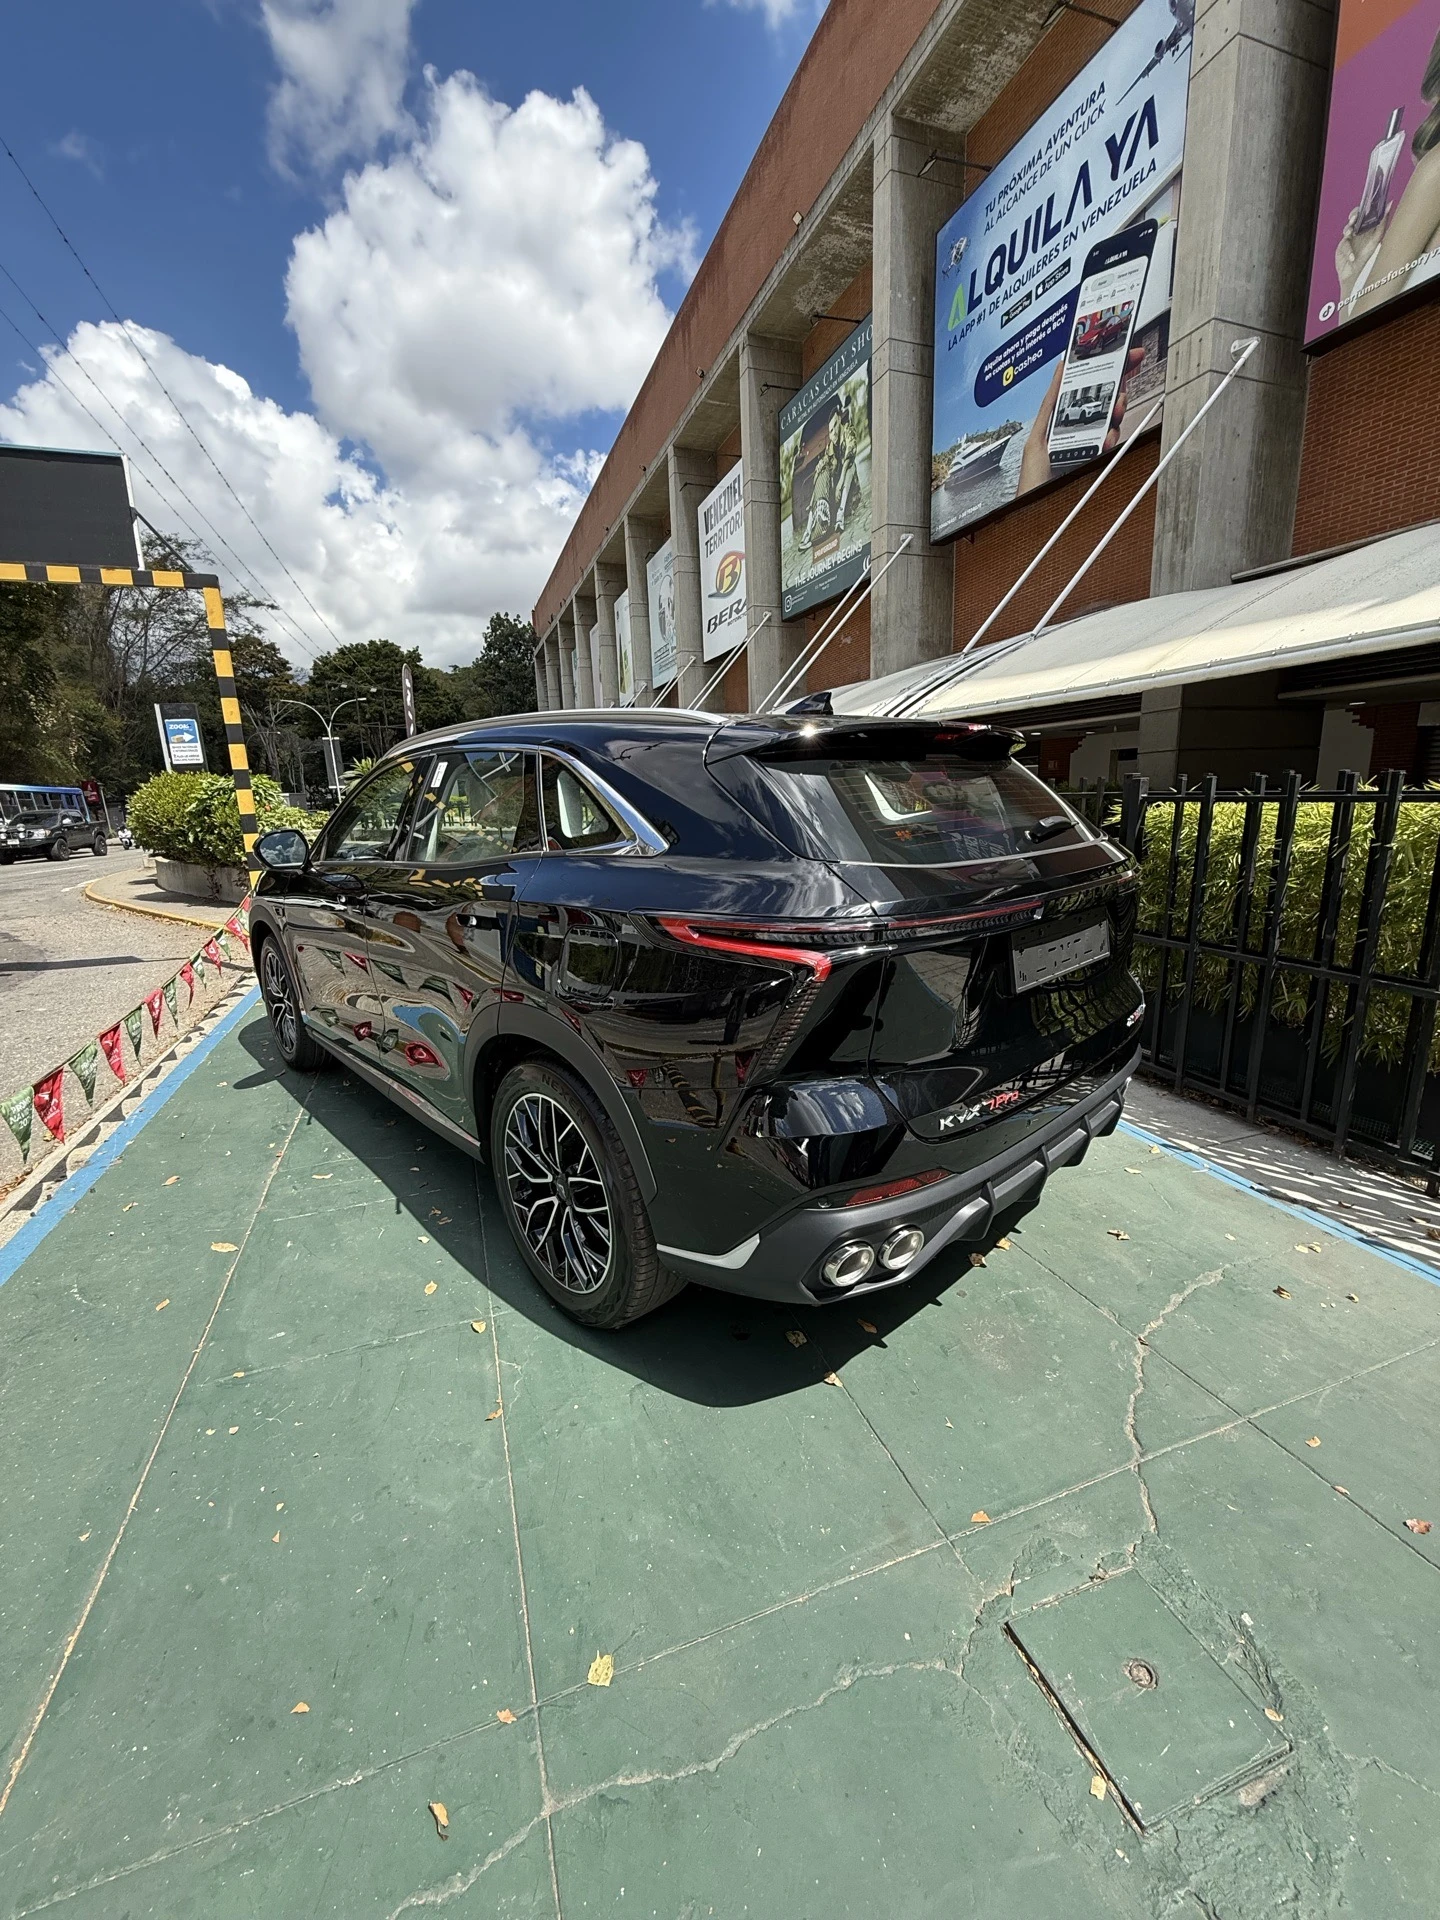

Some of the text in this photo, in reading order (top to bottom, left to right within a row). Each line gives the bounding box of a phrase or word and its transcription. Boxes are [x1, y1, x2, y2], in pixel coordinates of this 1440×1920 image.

[984, 81, 1106, 218] TU PRÓXIMA AVENTURA
[984, 99, 1107, 235] AL ALCANCE DE UN CLICK
[948, 95, 1159, 331] ALQUILA YA
[947, 334, 959, 351] LA
[959, 320, 976, 344] APP
[976, 309, 987, 326] #1
[988, 295, 1001, 316] DE
[1001, 243, 1061, 305] ALQUILERES
[1062, 226, 1079, 252] EN
[1081, 157, 1157, 234] VENEZUELA
[992, 359, 1012, 376] cuotas
[1016, 346, 1026, 359] sin
[1025, 330, 1047, 351] interés
[1052, 314, 1067, 331] BCV
[1003, 341, 1020, 359] ahora
[1025, 325, 1041, 343] paga
[1041, 303, 1069, 328] después
[1013, 348, 1043, 376] cashea
[780, 324, 873, 430] CARACAS CITY SHO
[703, 473, 743, 535] VENEZUEL
[705, 507, 743, 558] TERRITORI
[795, 575, 807, 589] THE
[806, 556, 836, 581] JOURNEY
[836, 539, 863, 564] BEGINS
[541, 1073, 587, 1125] NEXEN
